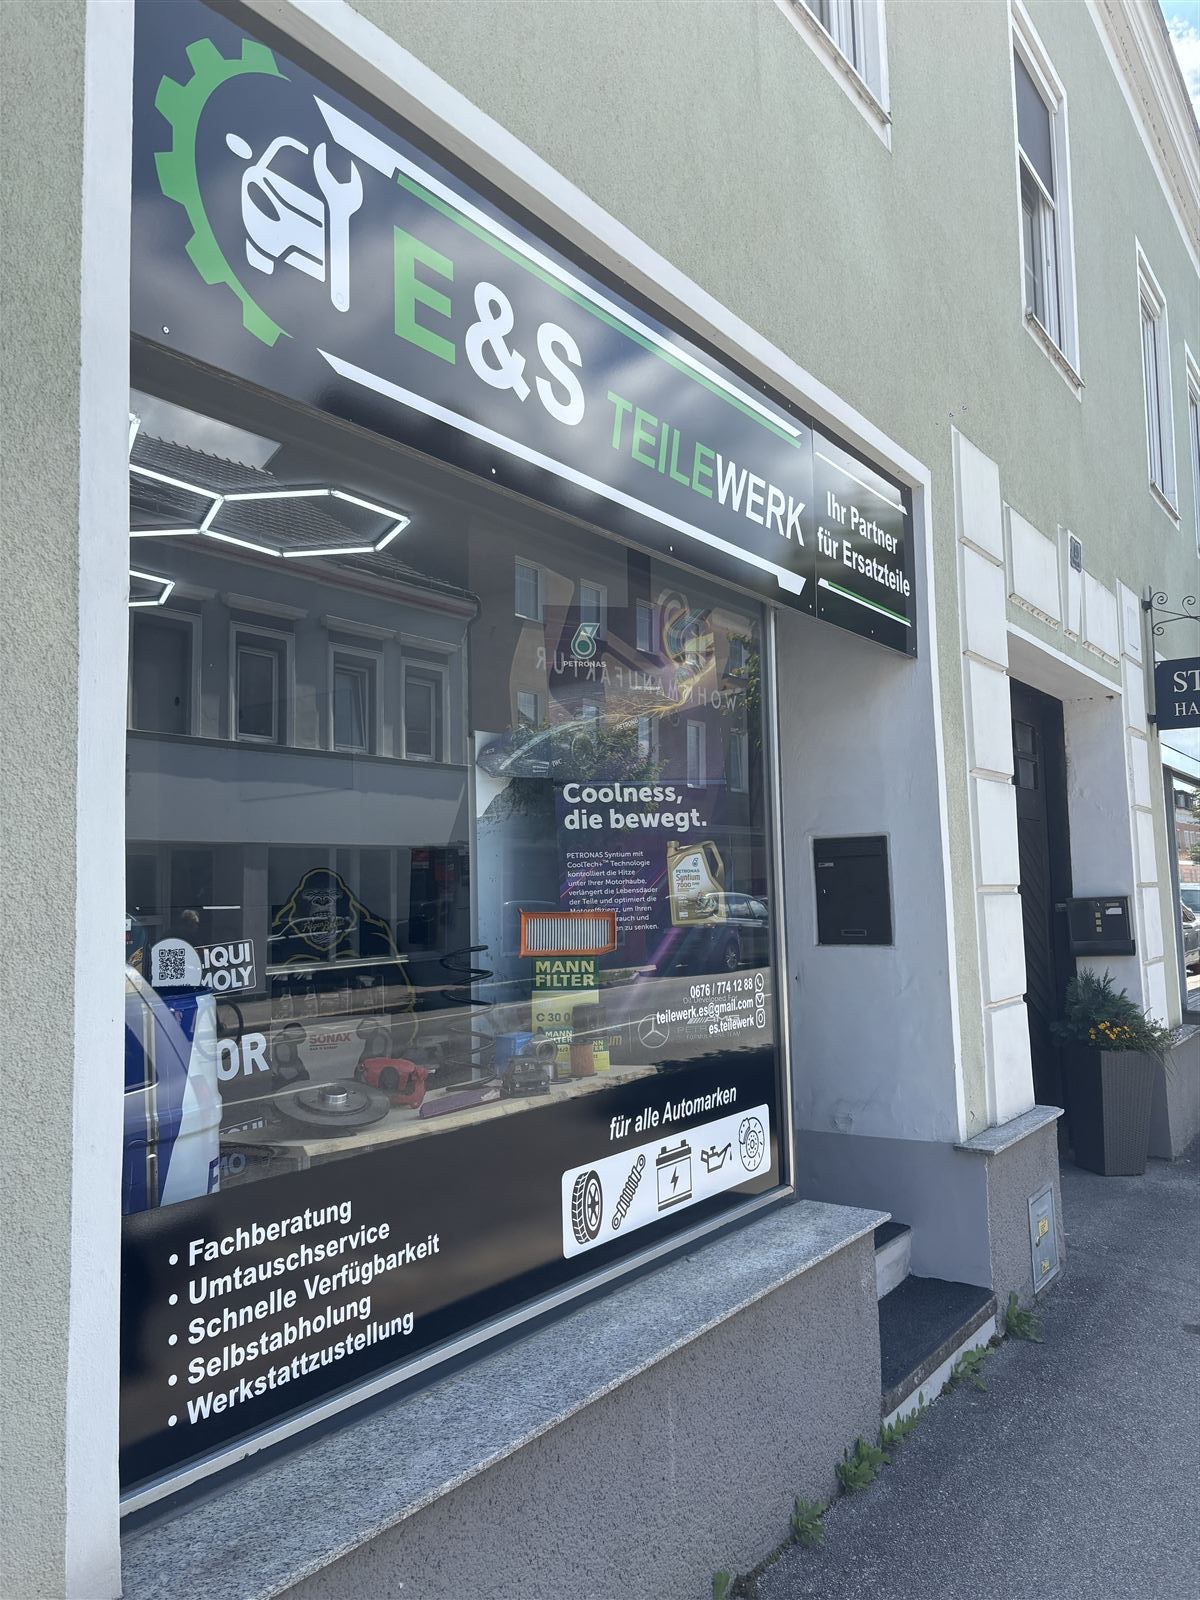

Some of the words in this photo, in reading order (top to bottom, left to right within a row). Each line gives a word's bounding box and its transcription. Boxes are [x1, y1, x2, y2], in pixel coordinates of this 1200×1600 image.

[394, 225, 585, 426] E&S
[607, 390, 806, 547] TEILEWERK
[827, 490, 847, 525] Ihr
[850, 505, 898, 555] Partner
[817, 526, 839, 560] für
[842, 539, 911, 597] Ersatzteile
[563, 660, 606, 668] PETRONAS
[562, 782, 683, 804] Coolness,
[564, 809, 604, 830] die
[610, 807, 707, 833] bewegt.
[604, 851, 632, 859] Syntium
[614, 896, 646, 904] optimiert
[616, 886, 658, 894] Lebensdauer
[201, 943, 251, 969] IQUI
[535, 960, 595, 973] MANN
[201, 965, 253, 991] MOLY
[535, 974, 595, 986] FILTER
[690, 984, 711, 998] 0676
[711, 982, 716, 995] /
[717, 980, 731, 994] 774
[733, 980, 742, 992] 12
[744, 978, 753, 990] 88
[536, 1012, 545, 1022] C
[548, 1012, 561, 1022] 30
[656, 998, 754, 1024] teilewerk.es@gmail.com
[708, 1014, 755, 1034] es.teilewerk
[309, 1032, 351, 1045] SONAX
[609, 1116, 631, 1140] für
[635, 1107, 659, 1133] alle
[662, 1087, 737, 1124] Automarken
[188, 1200, 352, 1266] Fachberatung
[188, 1223, 390, 1305] Umtauschservice
[188, 1288, 297, 1345] Schnelle
[304, 1233, 440, 1300] Verfügbarkeit
[188, 1296, 372, 1385] Selbstabholung
[187, 1312, 415, 1425] Werkstattzustellung
